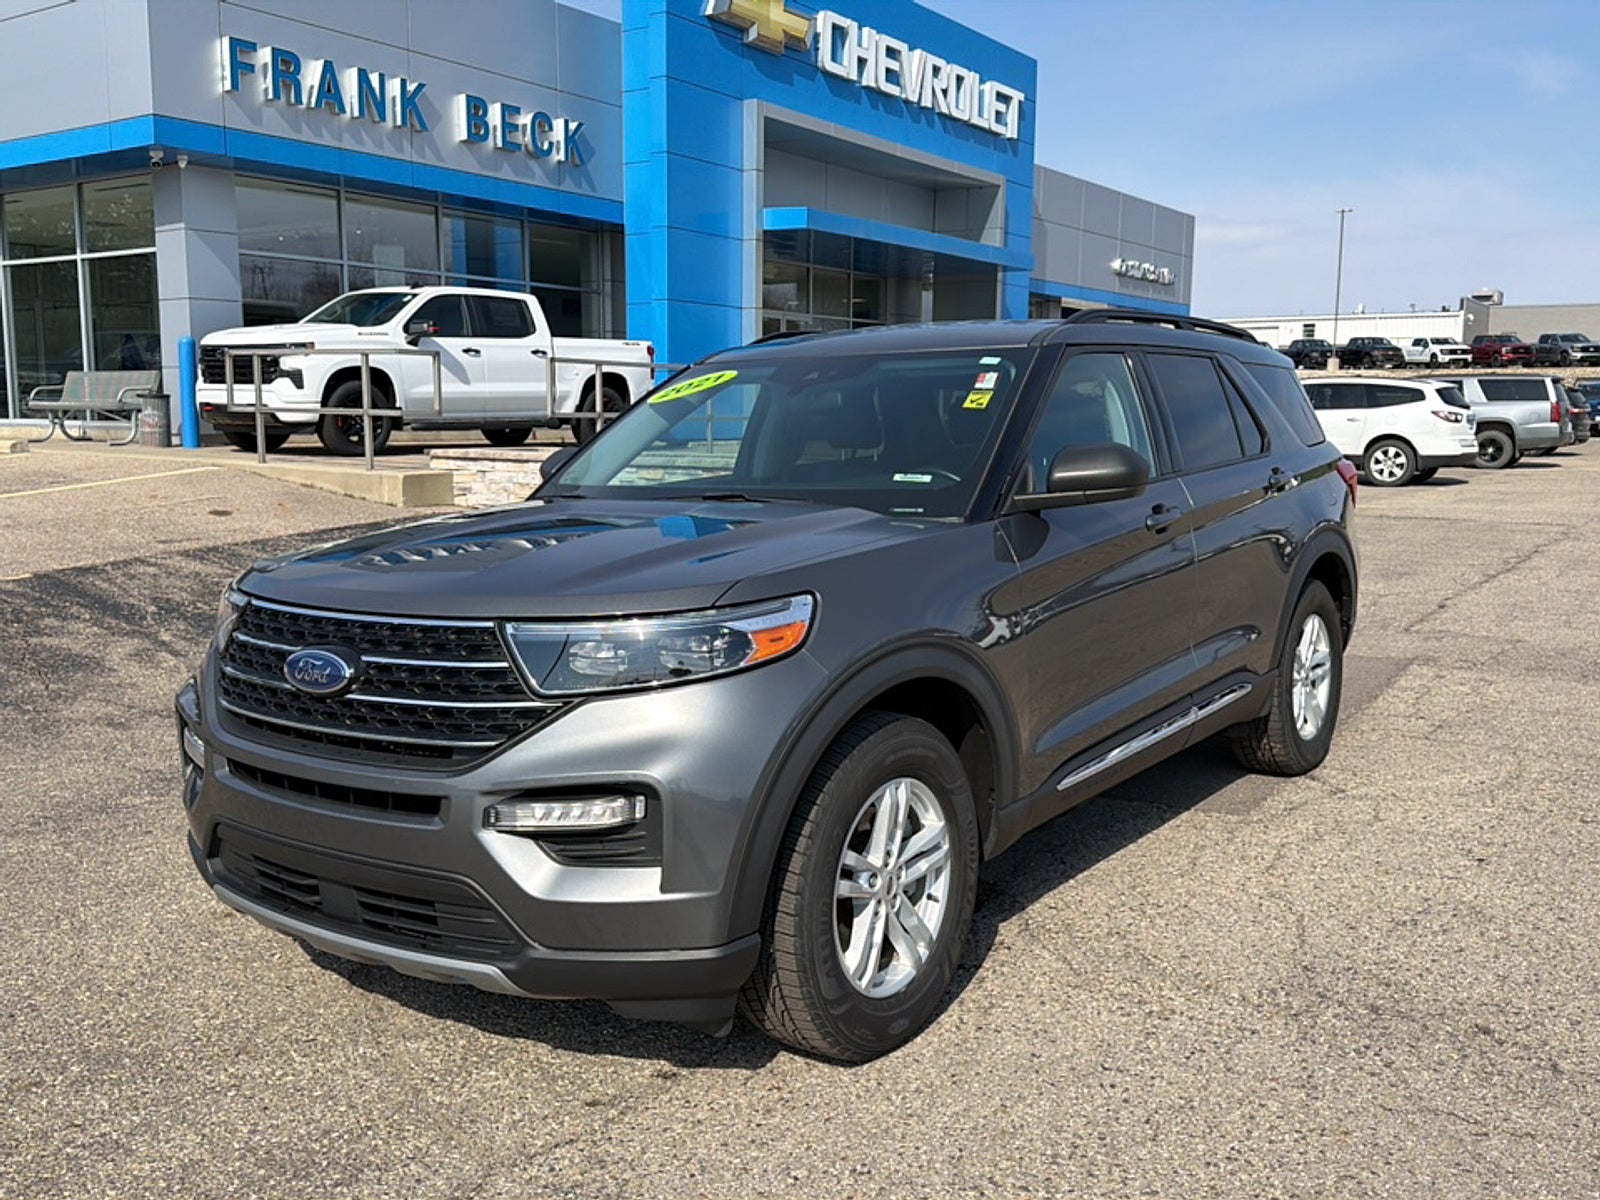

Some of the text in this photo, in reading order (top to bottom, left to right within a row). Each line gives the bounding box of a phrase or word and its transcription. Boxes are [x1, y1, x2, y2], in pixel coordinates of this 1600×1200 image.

[223, 35, 585, 166] FRANK BECK
[816, 10, 1025, 140] CHEVROLET
[295, 657, 332, 683] Ford
